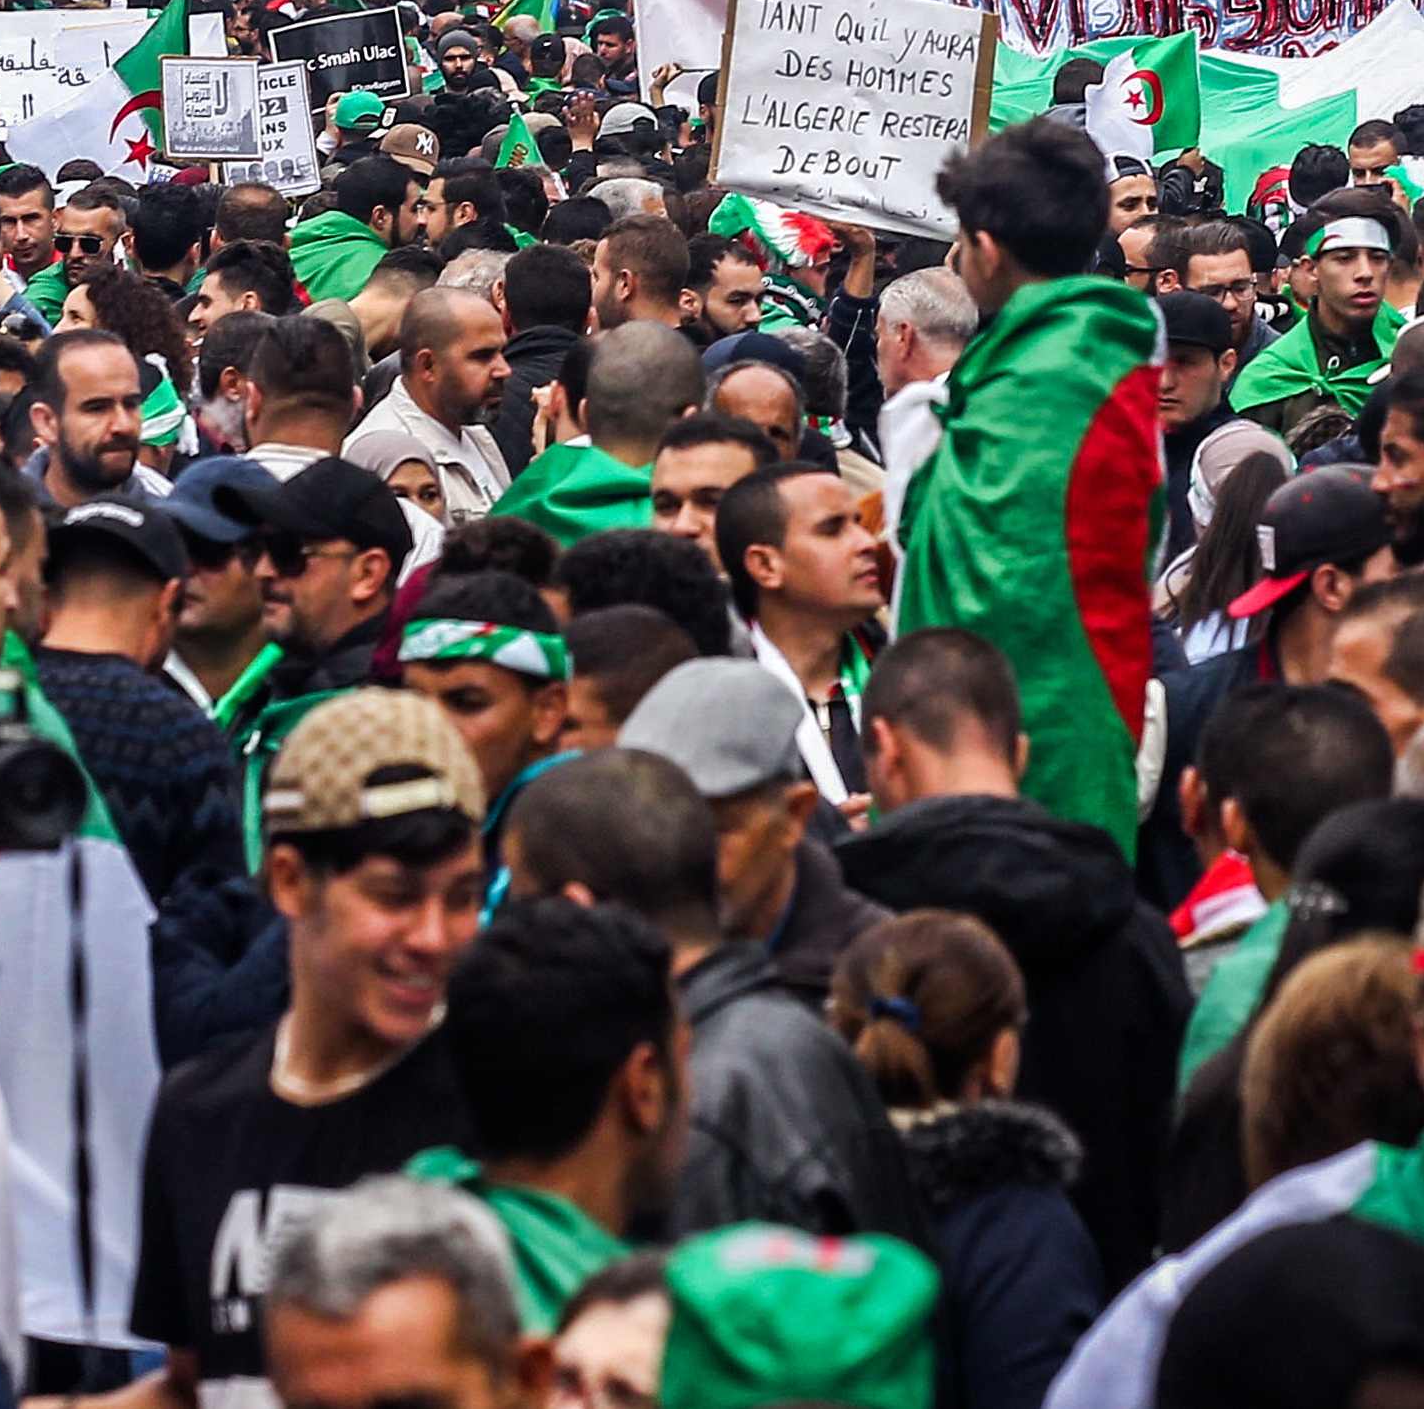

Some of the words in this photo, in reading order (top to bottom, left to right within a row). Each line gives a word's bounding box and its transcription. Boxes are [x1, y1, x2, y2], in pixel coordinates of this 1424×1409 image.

[317, 47, 361, 69] Smah
[363, 44, 397, 62] Ulac
[775, 50, 833, 82] DES
[846, 59, 954, 98] HOMMES
[742, 93, 871, 136] L'ALGERIE
